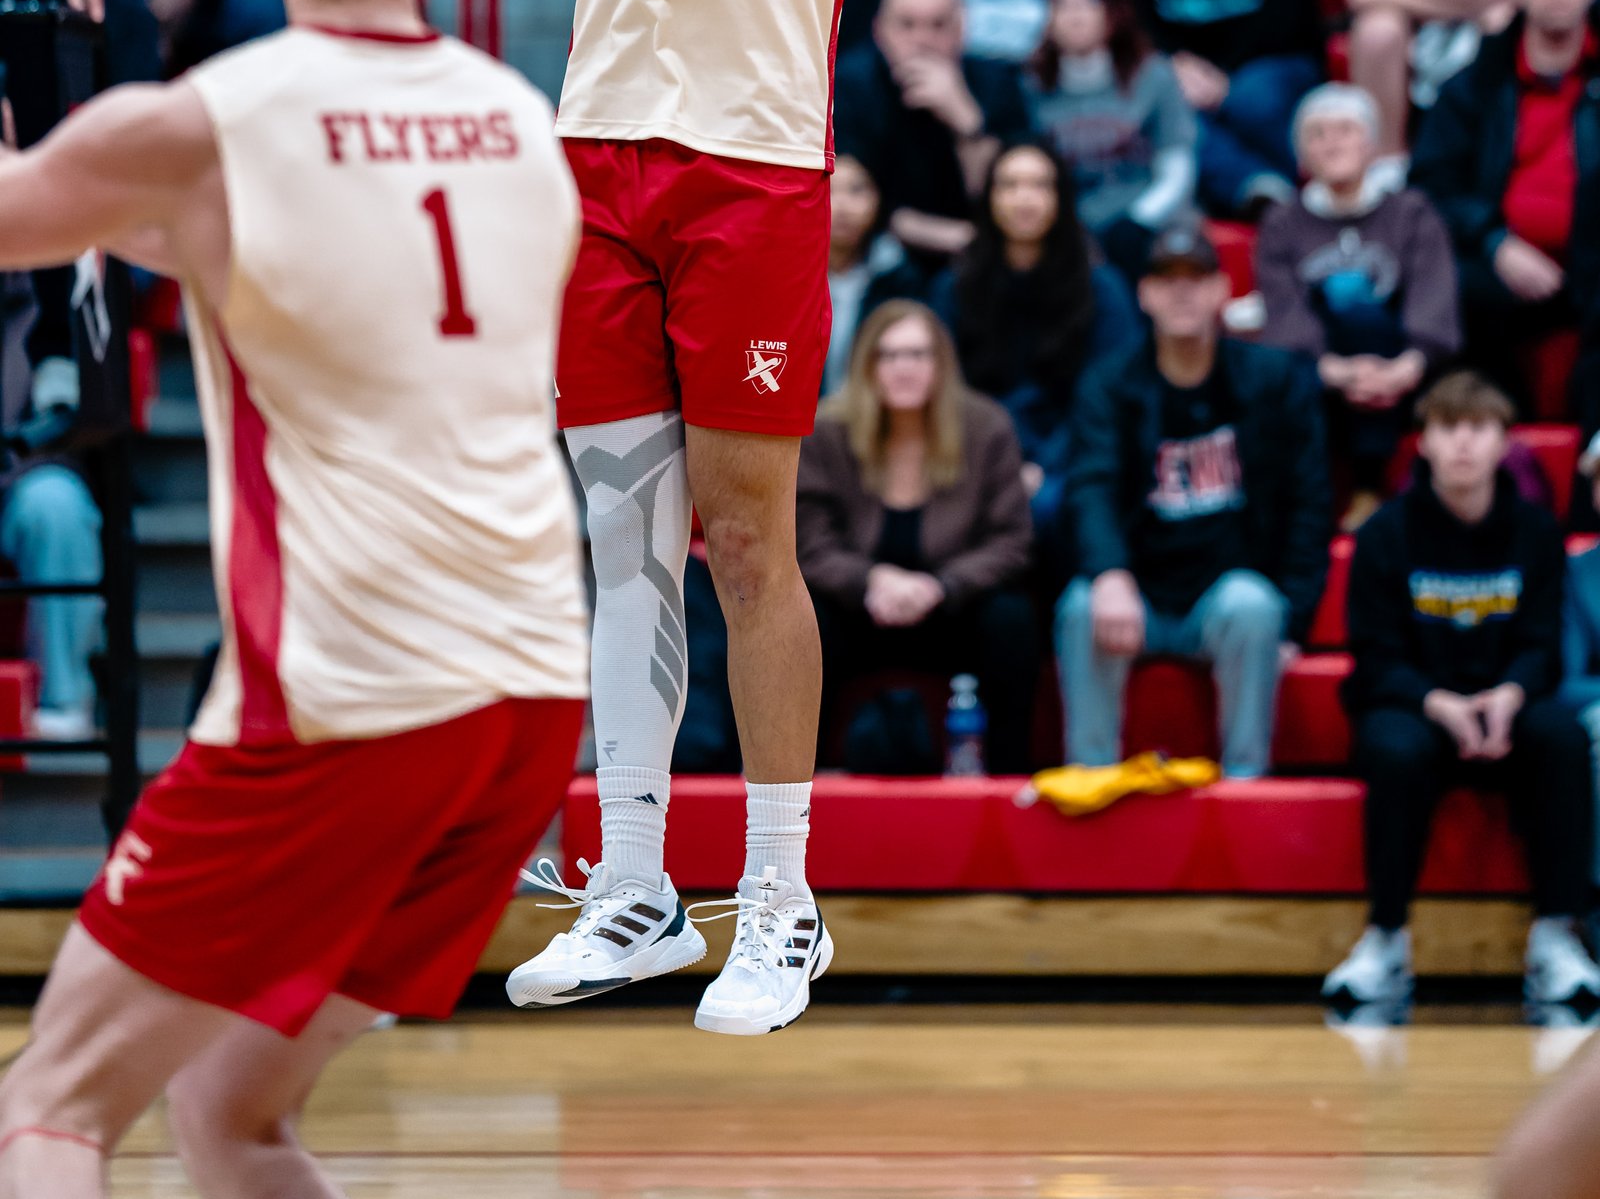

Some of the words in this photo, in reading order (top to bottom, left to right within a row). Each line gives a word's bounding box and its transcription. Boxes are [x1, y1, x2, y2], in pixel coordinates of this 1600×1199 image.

[318, 110, 522, 164] FLYERS
[420, 185, 478, 337] 1
[750, 339, 788, 351] LEWIS
